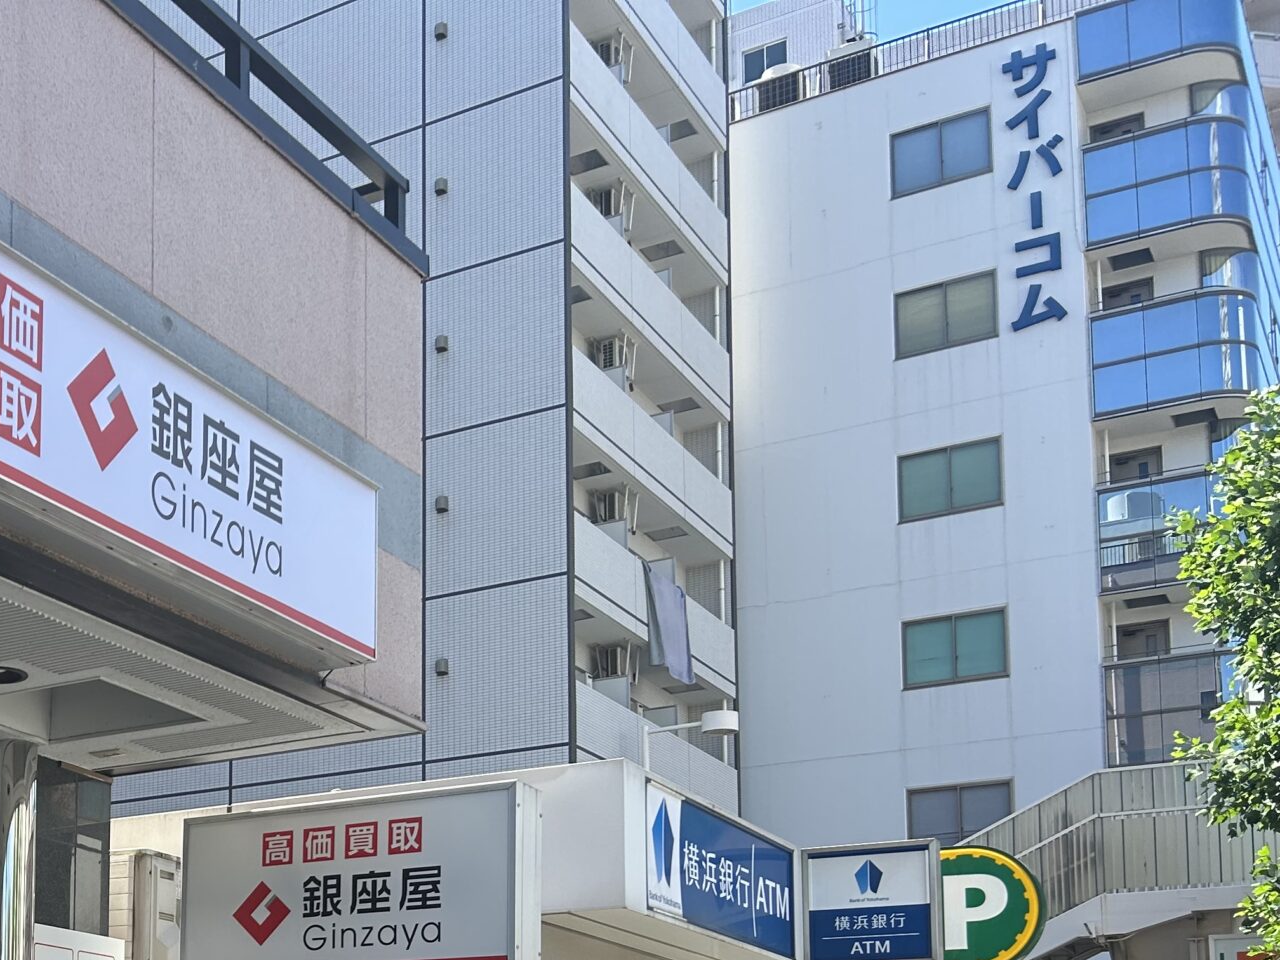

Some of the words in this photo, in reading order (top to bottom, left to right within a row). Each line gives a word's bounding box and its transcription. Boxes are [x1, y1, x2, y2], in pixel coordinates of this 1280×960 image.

[1002, 42, 1068, 332] サイバーコム
[151, 381, 283, 525] 銀座屋
[151, 471, 283, 577] Ginzaya
[264, 820, 422, 865] 高価買取
[302, 866, 442, 918] 銀座屋
[683, 840, 750, 908] 横浜銀行
[756, 876, 790, 921] ATM
[942, 873, 1008, 951] P
[303, 921, 442, 951] Ginzaya
[834, 913, 906, 931] 横浜銀行
[850, 940, 891, 955] ATM
